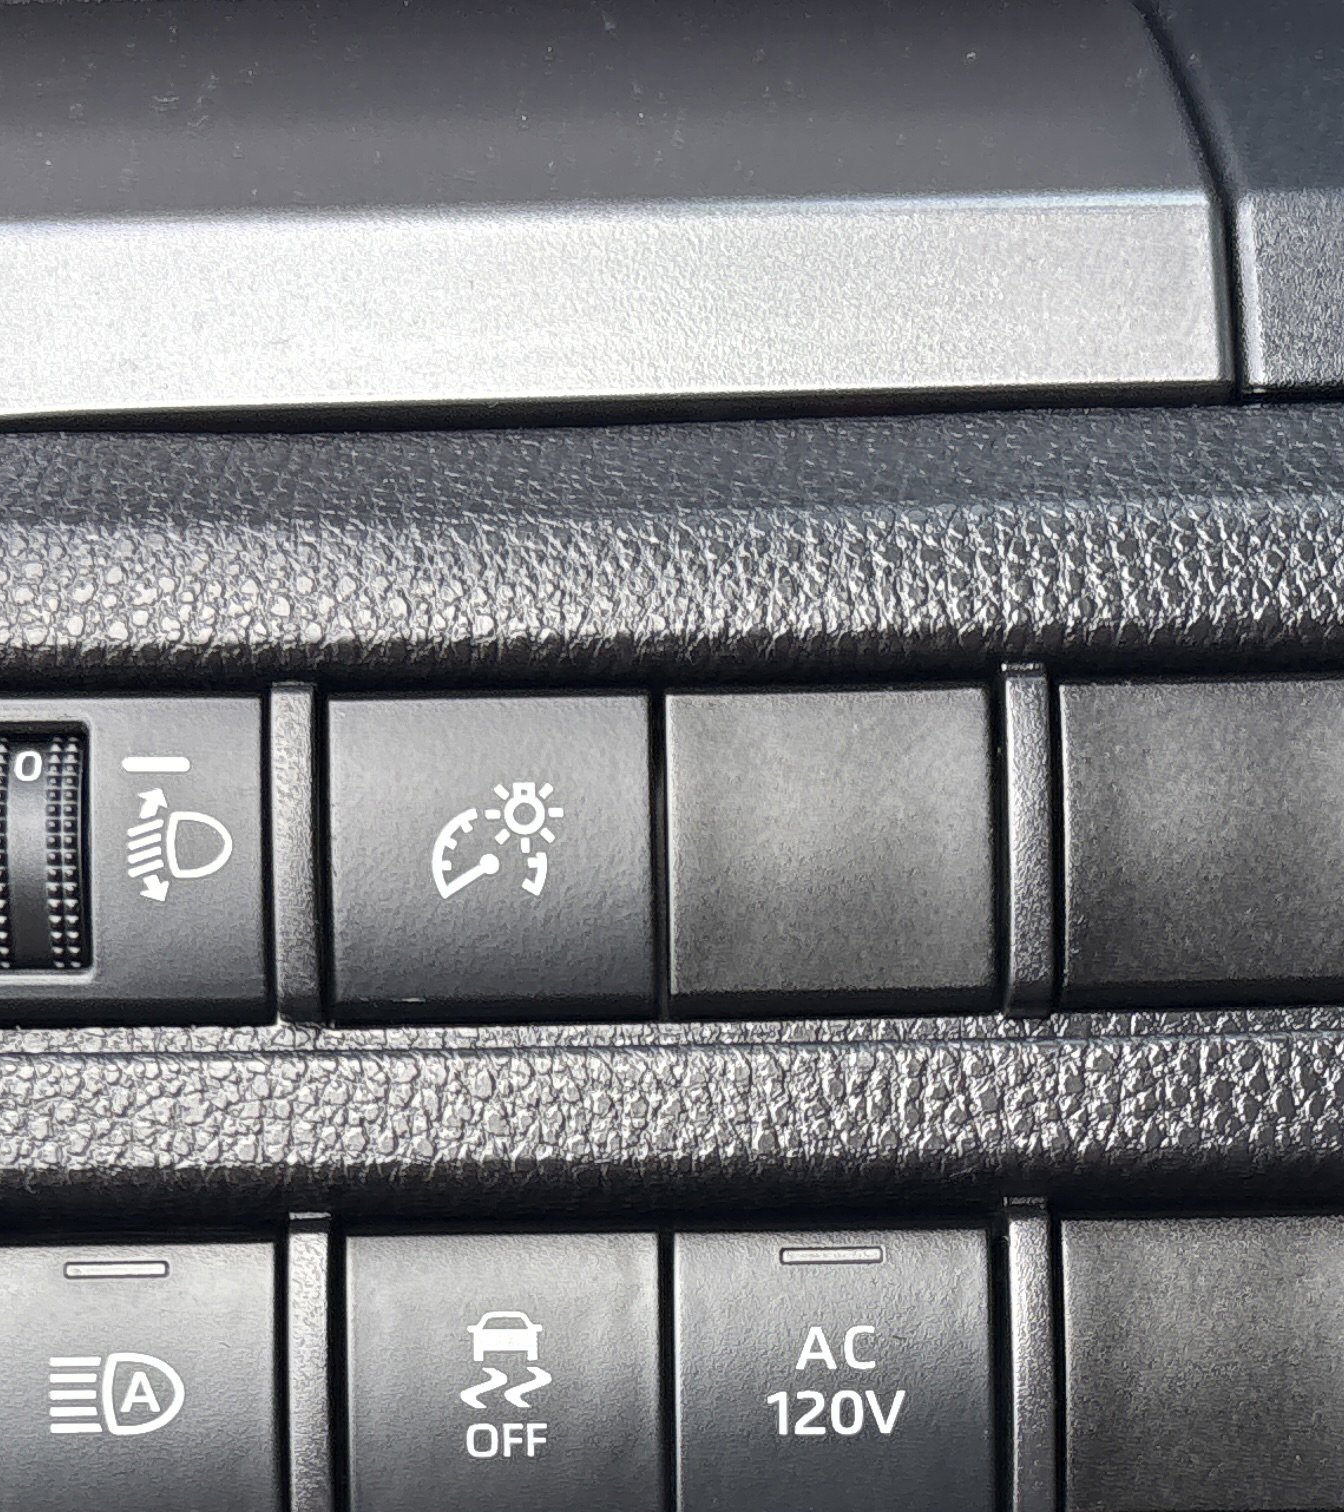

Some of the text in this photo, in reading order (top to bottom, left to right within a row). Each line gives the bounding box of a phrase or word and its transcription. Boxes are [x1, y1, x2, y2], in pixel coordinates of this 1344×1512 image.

[14, 750, 43, 782] 0
[795, 1325, 877, 1371] AC
[121, 1371, 162, 1414] A
[765, 1389, 907, 1436] 120V
[466, 1422, 548, 1459] OFF
